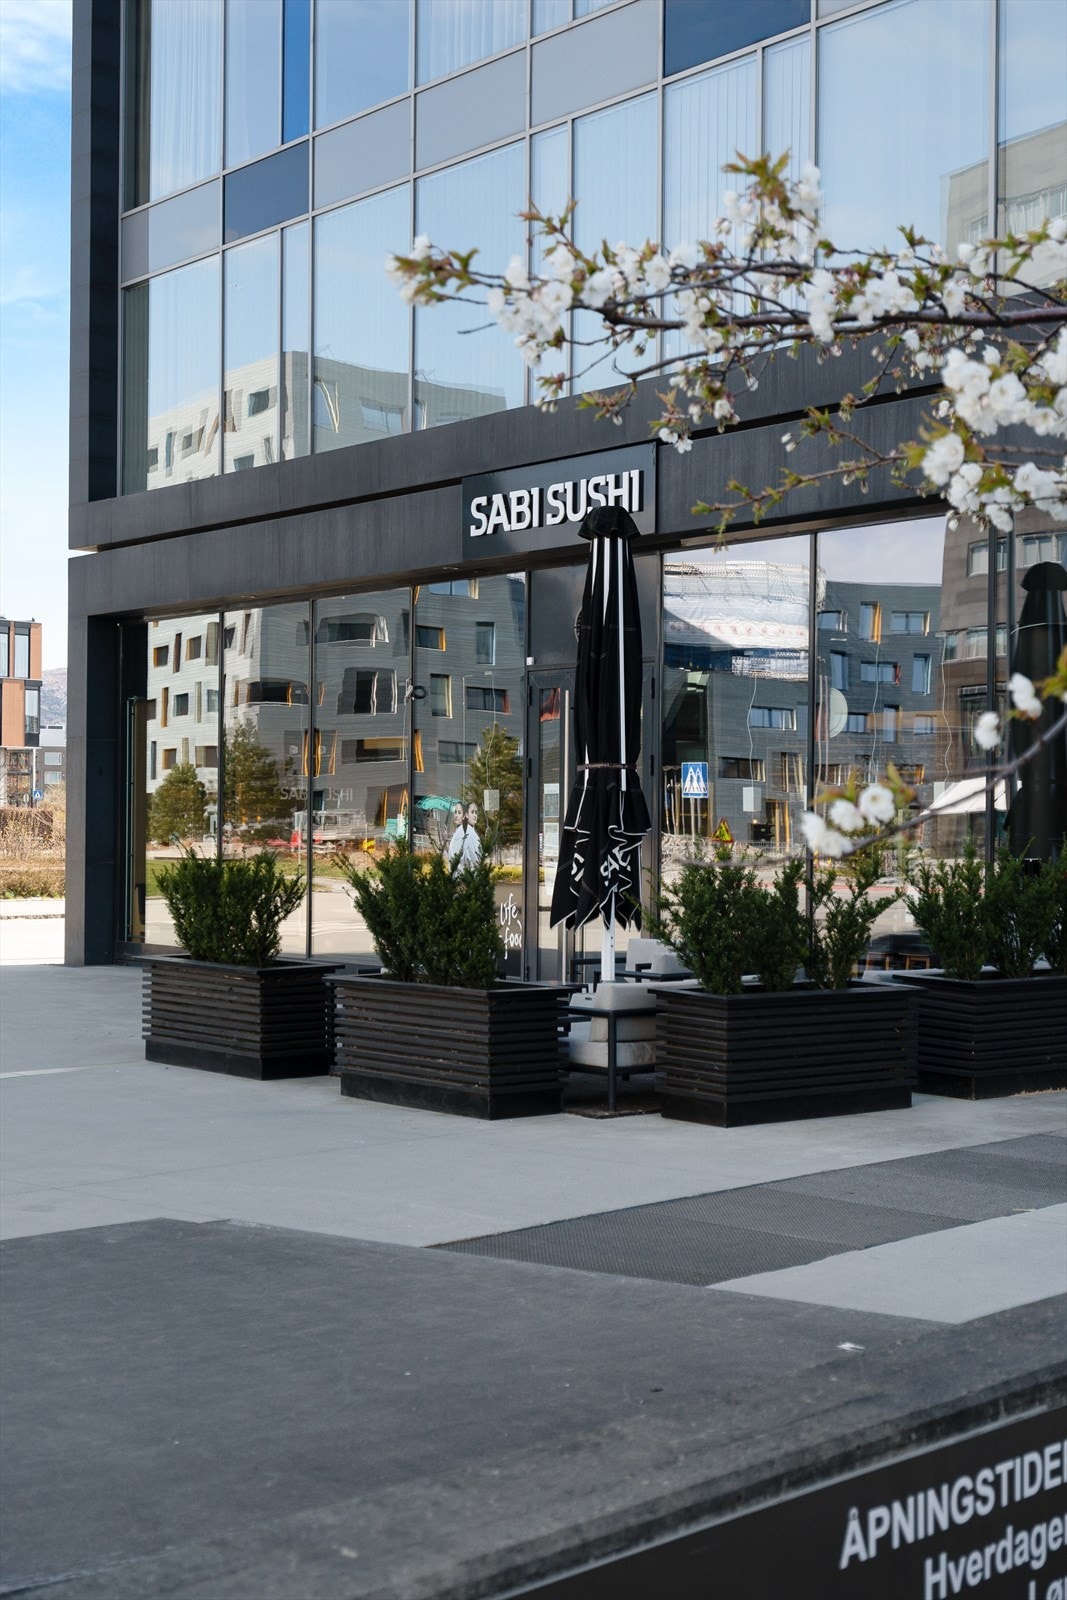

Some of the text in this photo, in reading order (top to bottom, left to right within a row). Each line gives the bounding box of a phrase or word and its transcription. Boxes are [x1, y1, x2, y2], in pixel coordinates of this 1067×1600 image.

[470, 469, 640, 537] SABI SUSHI
[280, 786, 308, 800] SAB
[839, 1439, 1067, 1571] ÅPNINGSTIDE
[923, 1515, 1067, 1600] Hverdage
